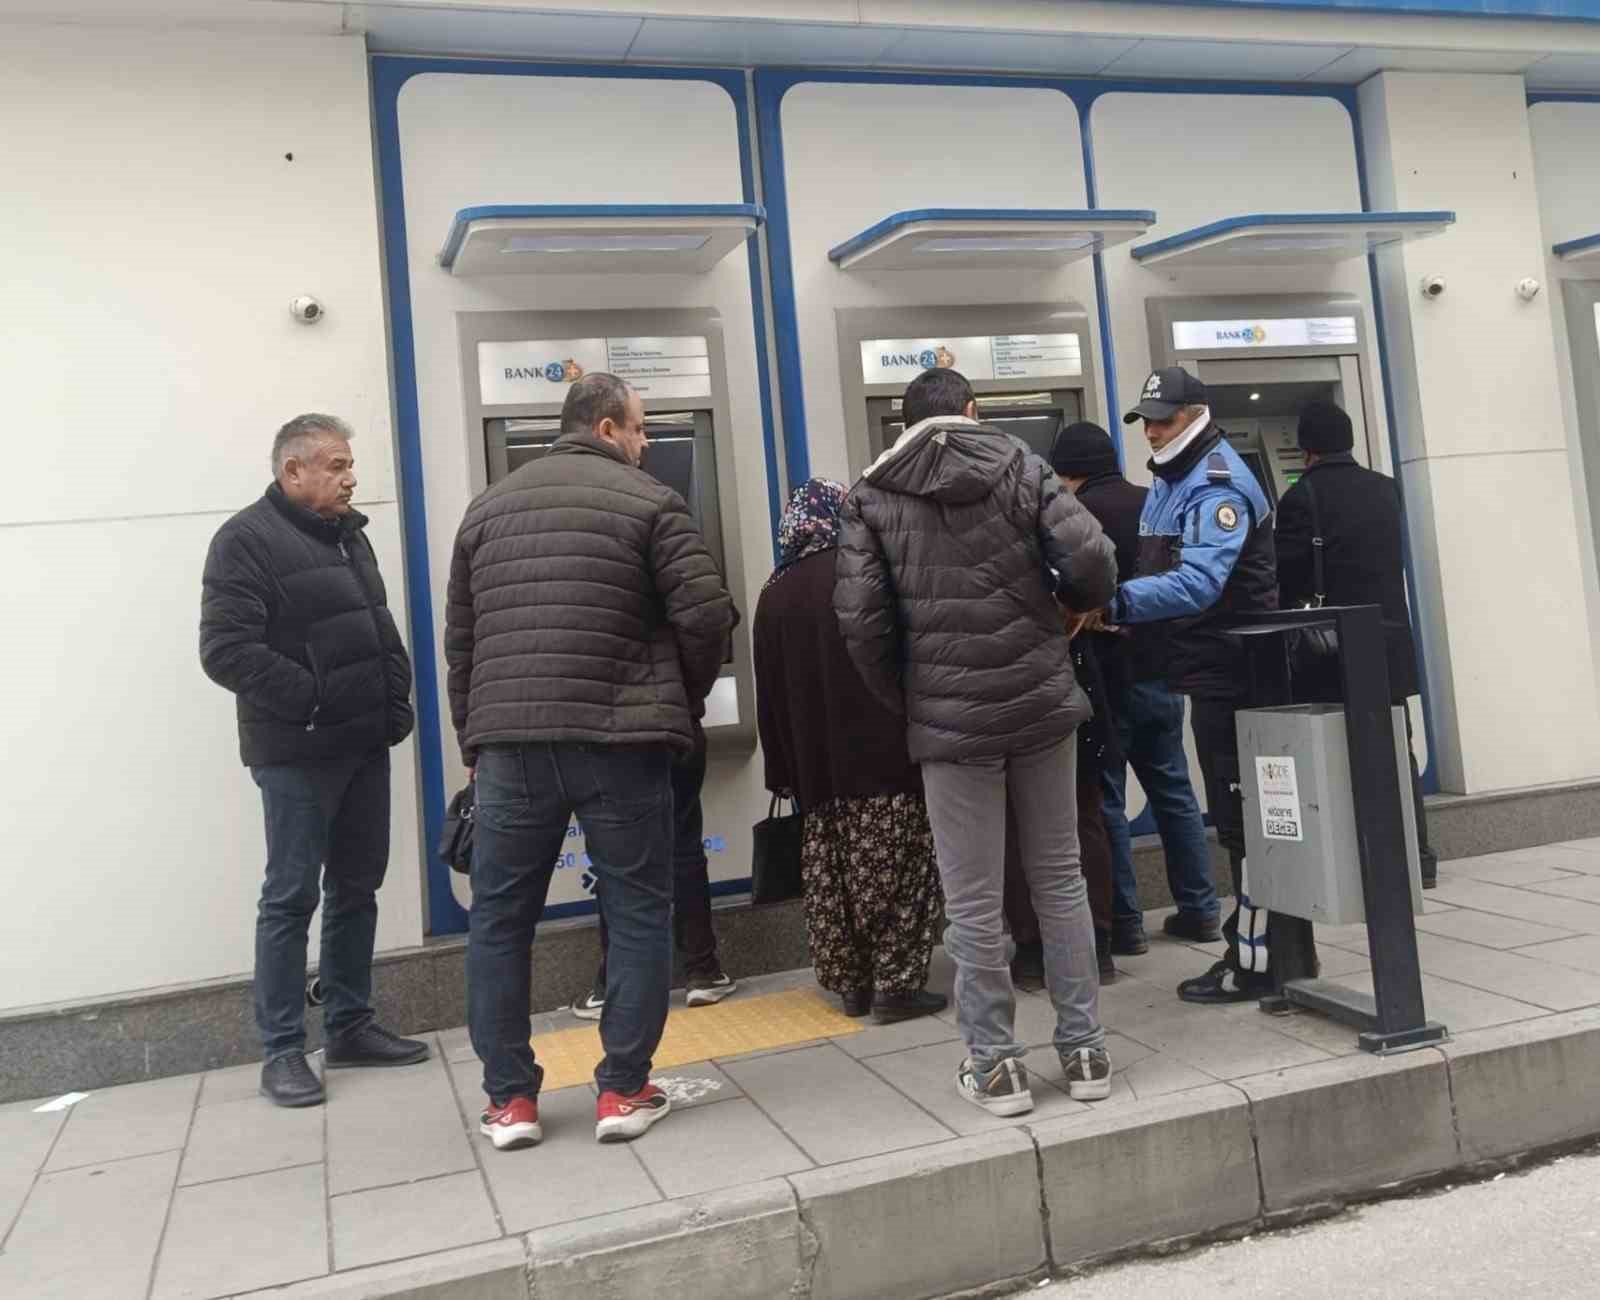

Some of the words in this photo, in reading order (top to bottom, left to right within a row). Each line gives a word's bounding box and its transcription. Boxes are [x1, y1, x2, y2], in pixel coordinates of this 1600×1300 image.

[1216, 331, 1241, 340] BANK
[882, 353, 918, 367] BANK
[504, 367, 544, 380] BANK
